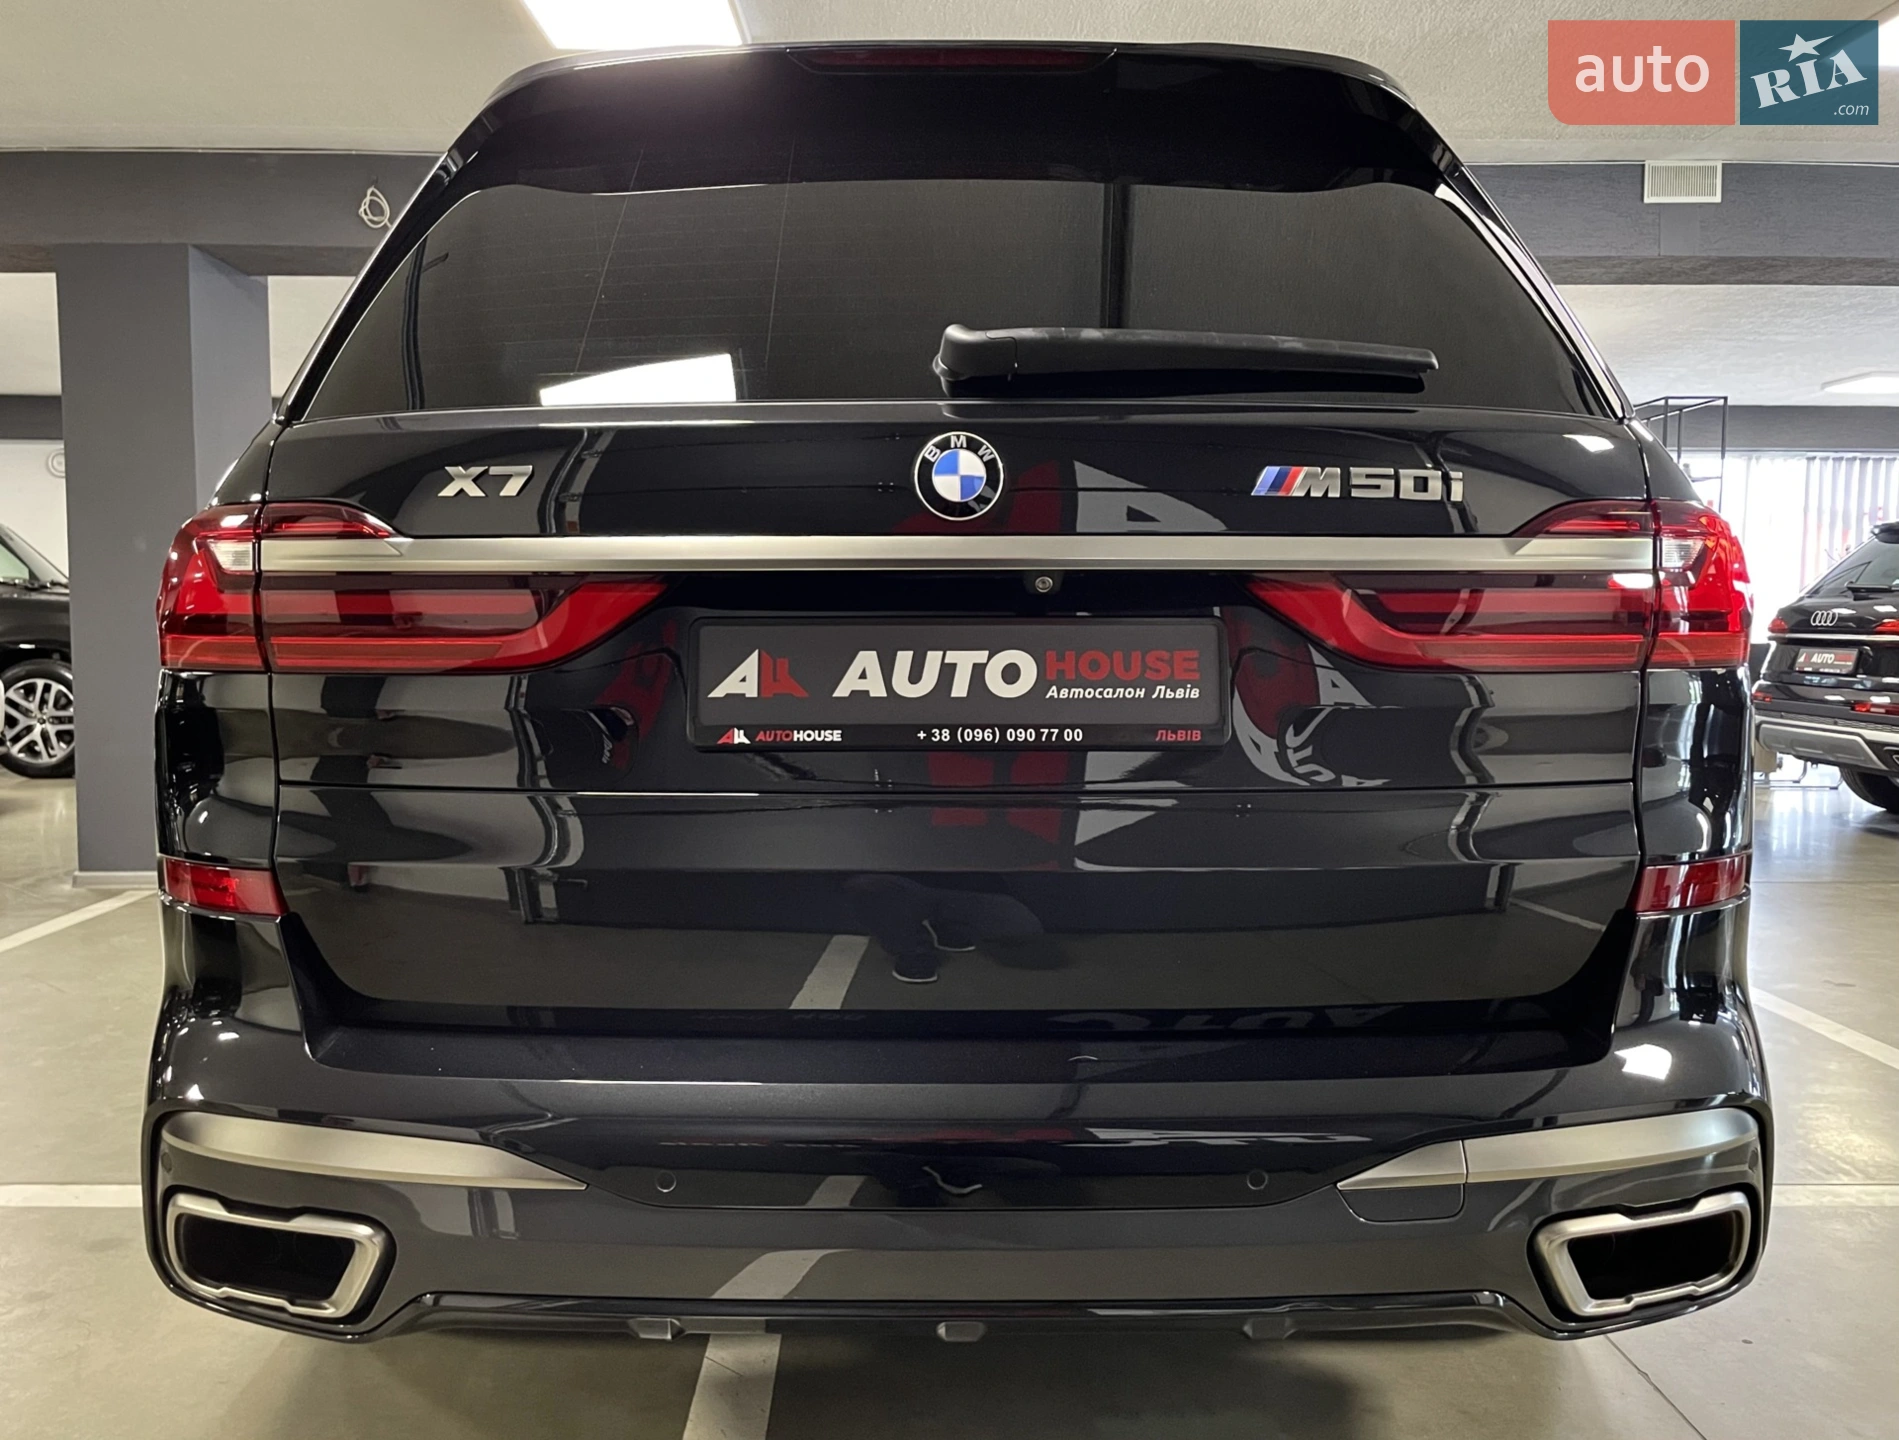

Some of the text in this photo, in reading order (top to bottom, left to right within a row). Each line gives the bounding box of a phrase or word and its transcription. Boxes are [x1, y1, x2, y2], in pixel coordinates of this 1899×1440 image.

[924, 434, 995, 462] BMW
[438, 465, 533, 496] X7
[1810, 653, 1835, 664] AUTO
[832, 650, 1037, 698] AUTO
[1045, 650, 1200, 681] HOUSE
[1045, 685, 1200, 699] Автосалон Львів
[755, 730, 842, 742] AUTOHOUSE
[931, 729, 950, 741] 38
[957, 728, 1000, 743] (096)
[1006, 729, 1036, 741] 090
[1040, 729, 1060, 741] 77
[1064, 729, 1083, 741] 00
